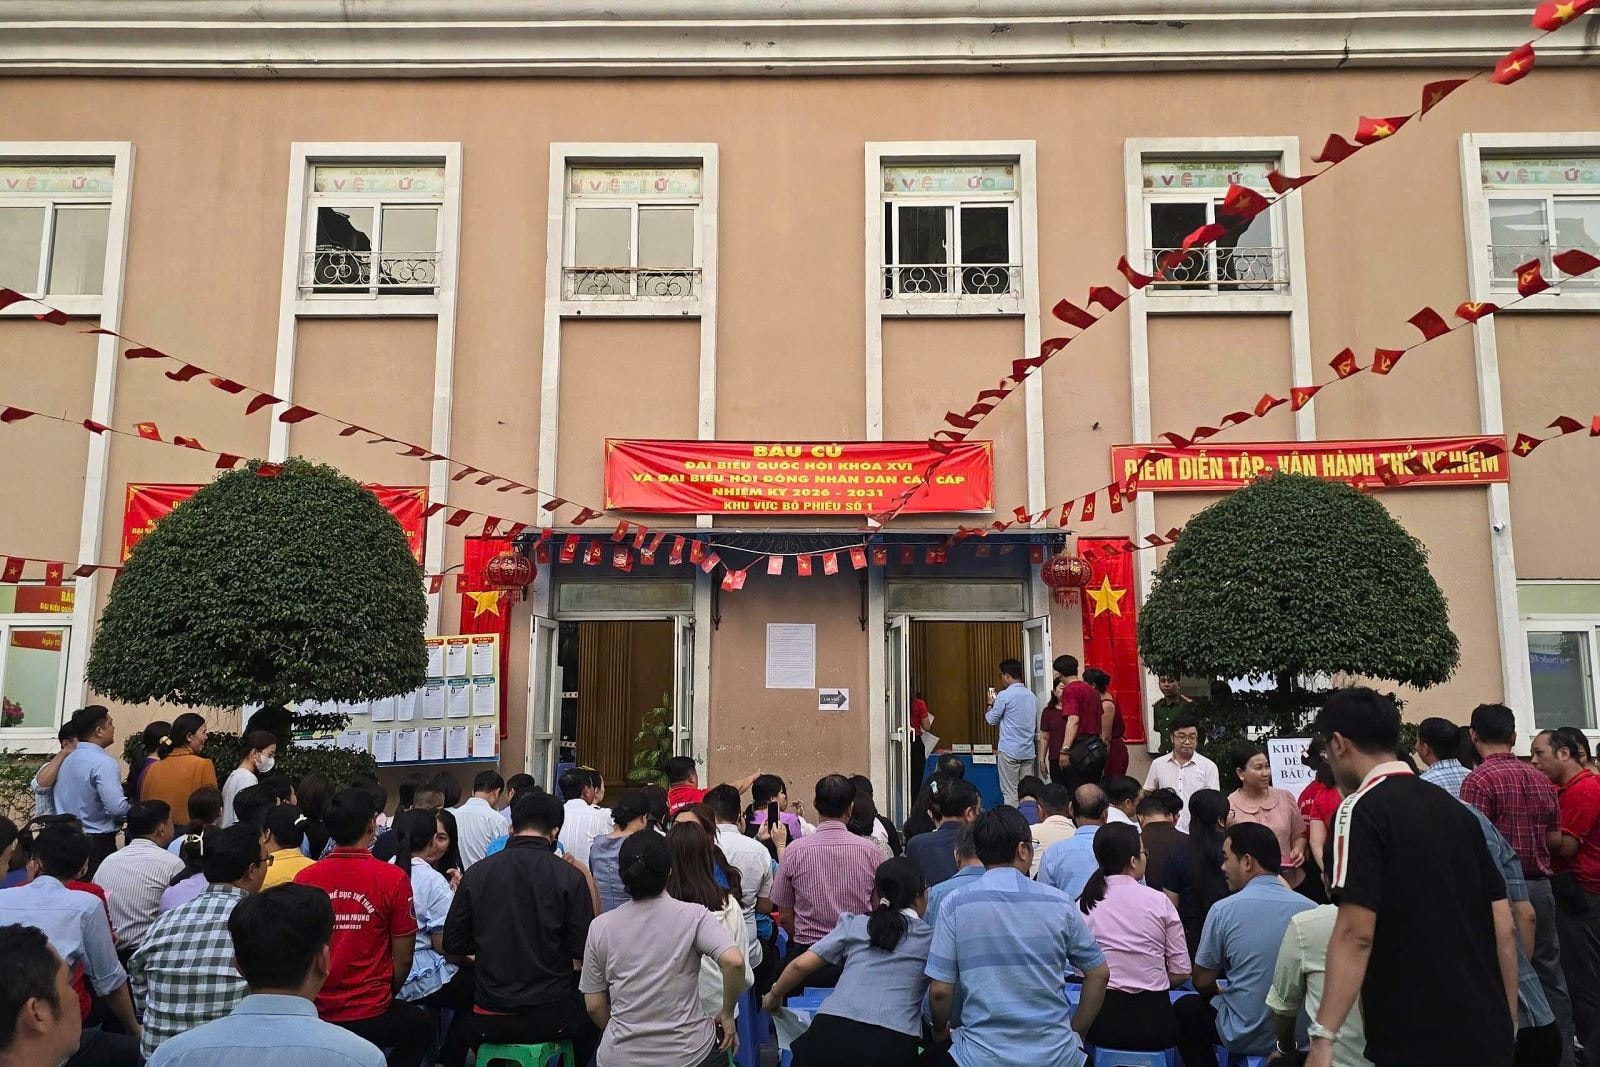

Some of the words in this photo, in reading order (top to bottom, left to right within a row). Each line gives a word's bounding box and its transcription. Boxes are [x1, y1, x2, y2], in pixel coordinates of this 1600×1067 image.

[753, 442, 802, 458] BẦU
[810, 442, 844, 458] CỬ
[756, 459, 800, 471] QUỐC
[804, 461, 833, 472] HỘI
[886, 462, 913, 471] XVI
[1178, 449, 1224, 480] DIỄN
[1322, 449, 1376, 477] HÀNH
[658, 473, 685, 484] ĐẠI
[690, 472, 725, 483] BIỂU
[730, 474, 758, 485] HỘI
[814, 473, 859, 484] NHÂN
[864, 473, 898, 484] DÂN
[936, 473, 966, 485] CẤP
[712, 486, 763, 498] NHIỆM
[792, 488, 830, 498] 2026
[847, 488, 884, 497] 2031
[724, 502, 750, 511] KHU
[753, 500, 778, 512] VỰC
[782, 499, 800, 511] BỎ
[803, 500, 841, 511] PHIẾU
[845, 499, 863, 511] SỐ
[866, 502, 873, 511] 1
[1273, 744, 1298, 753] KHU
[1281, 766, 1305, 779] BẦU
